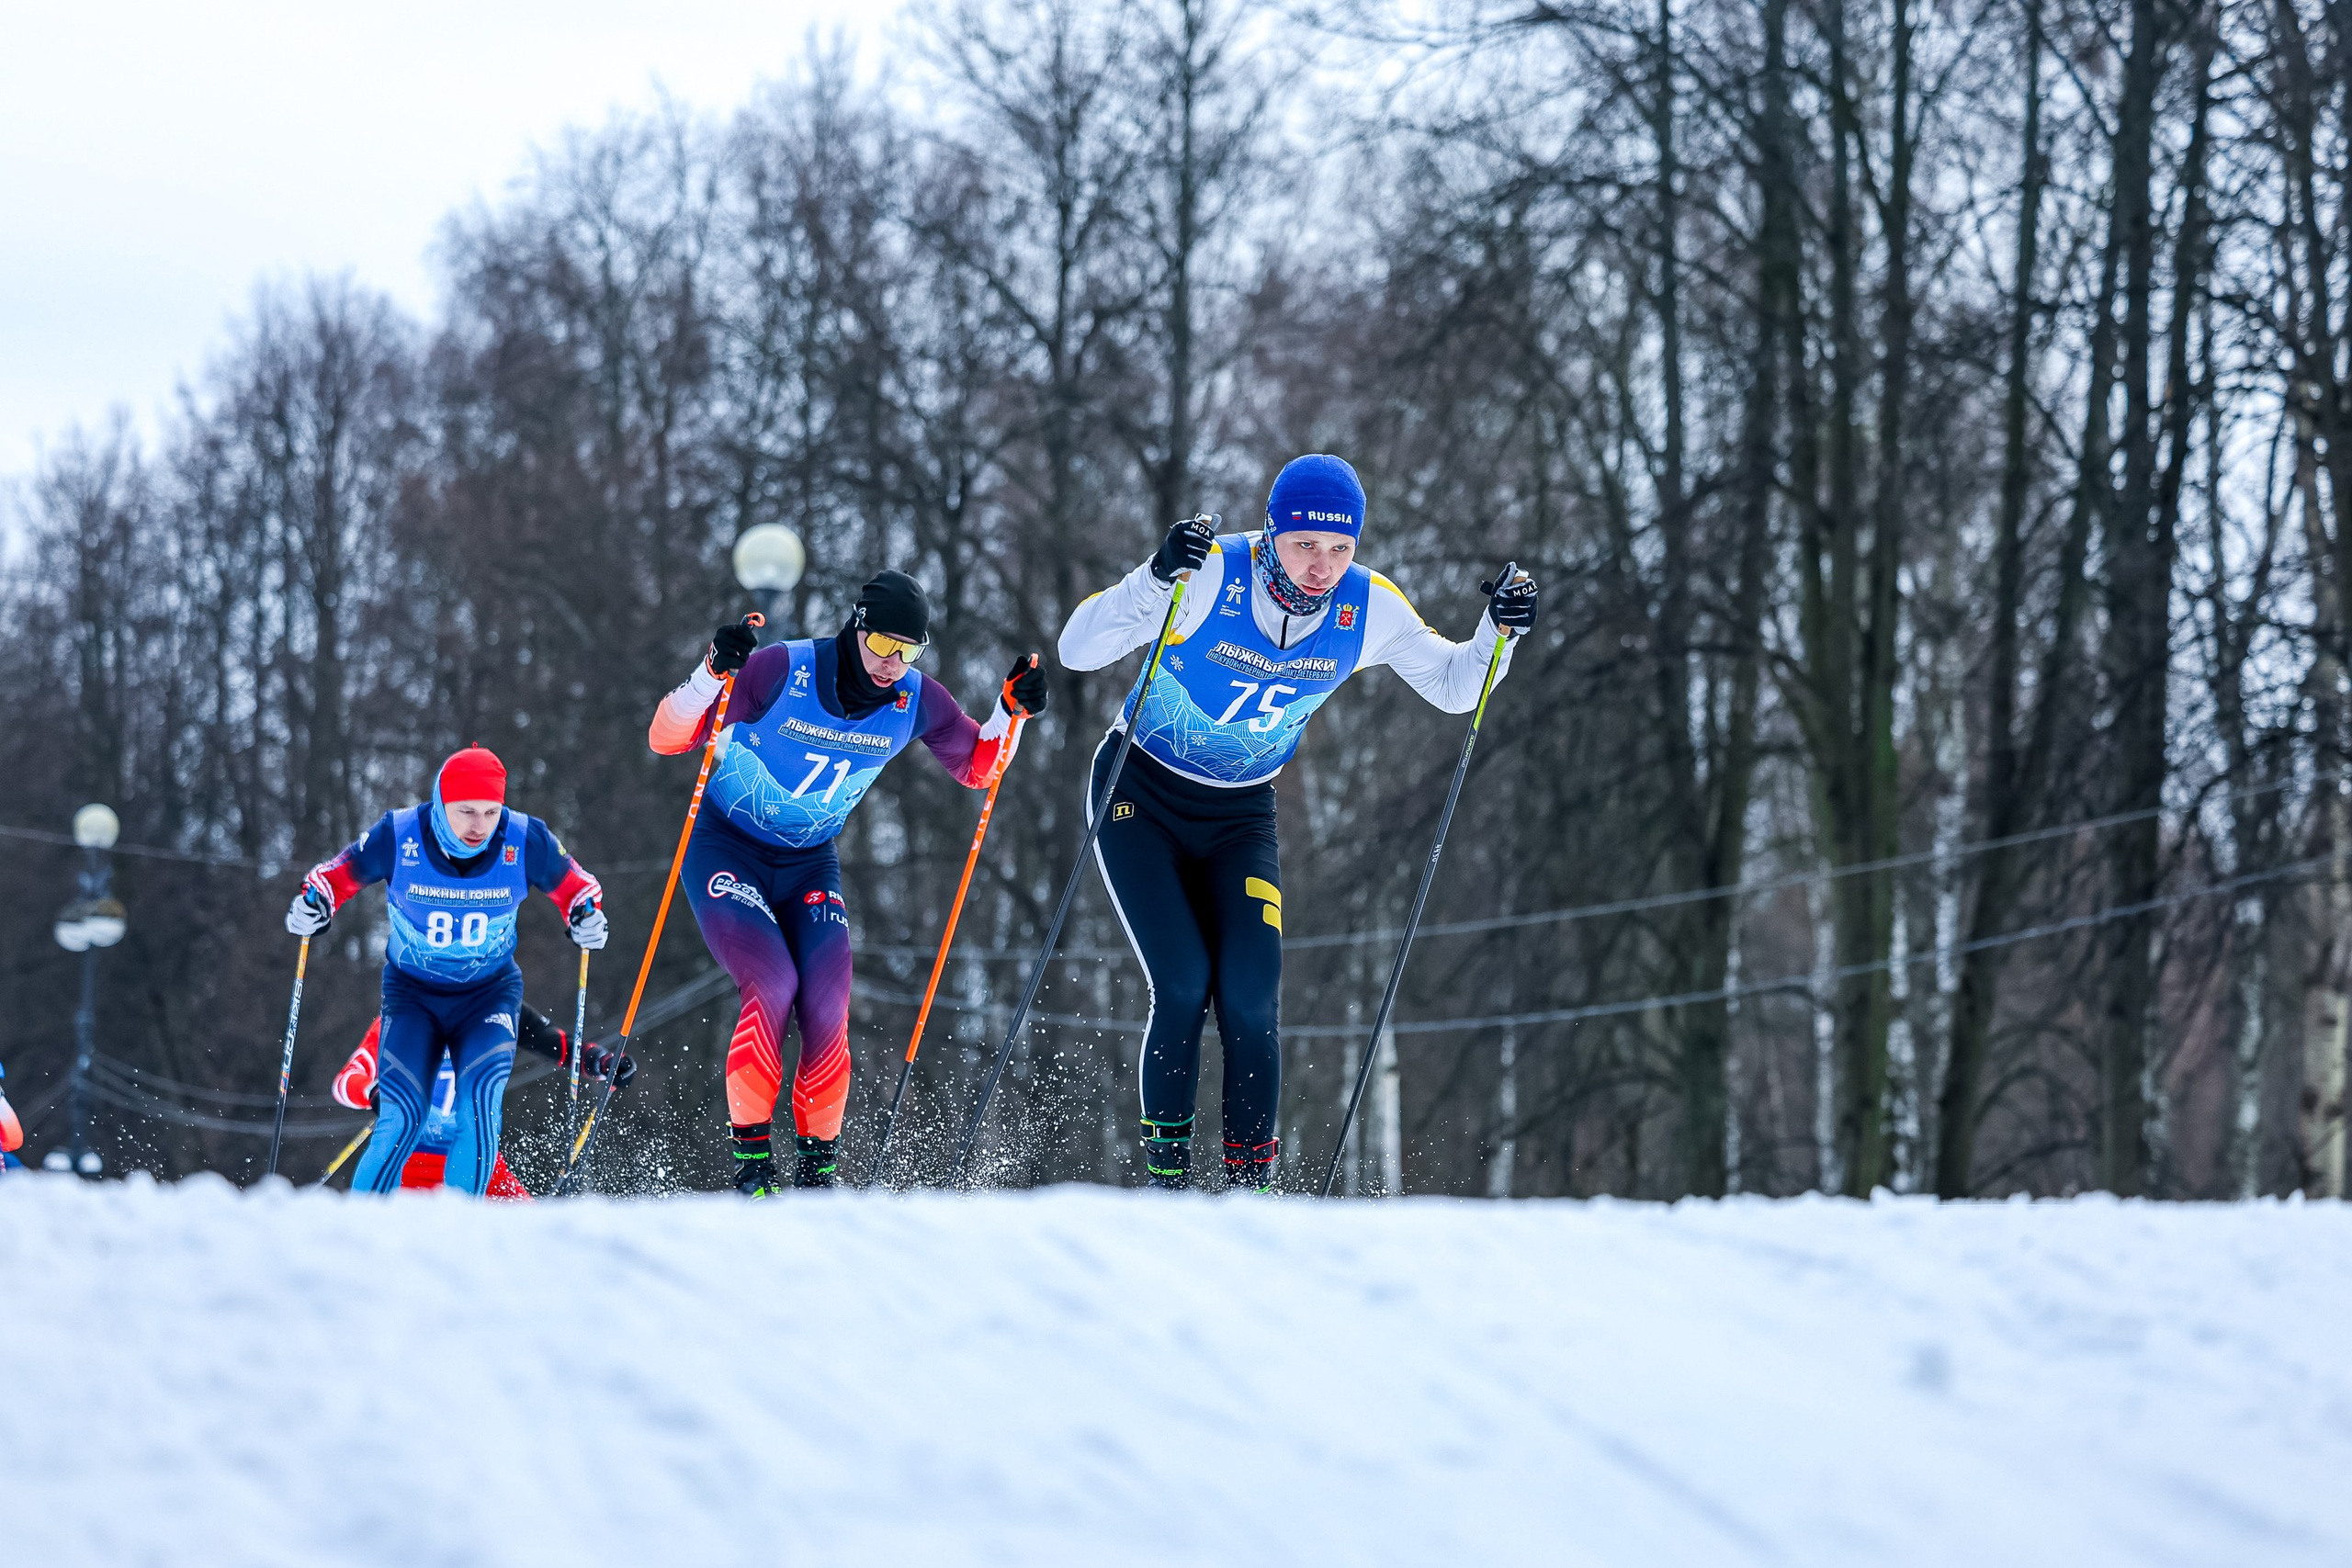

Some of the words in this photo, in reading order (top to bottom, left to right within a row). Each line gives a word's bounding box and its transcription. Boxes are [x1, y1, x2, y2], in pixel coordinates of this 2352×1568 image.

[1307, 511, 1352, 525] RUSSIA
[1216, 642, 1285, 673] ЛЫЖНЫЕ
[1287, 659, 1336, 671] ОНКИ
[1214, 680, 1297, 732] 75
[786, 718, 845, 741] ЛЫЖНЫЕ
[847, 734, 891, 748] ГОНКИ
[791, 752, 852, 804] 71
[410, 884, 467, 900] ЛЫЖНЫЕ
[469, 887, 510, 900] ГОНКИ
[730, 894, 741, 902] SKI
[741, 897, 756, 908] CLUB
[427, 910, 489, 948] 80
